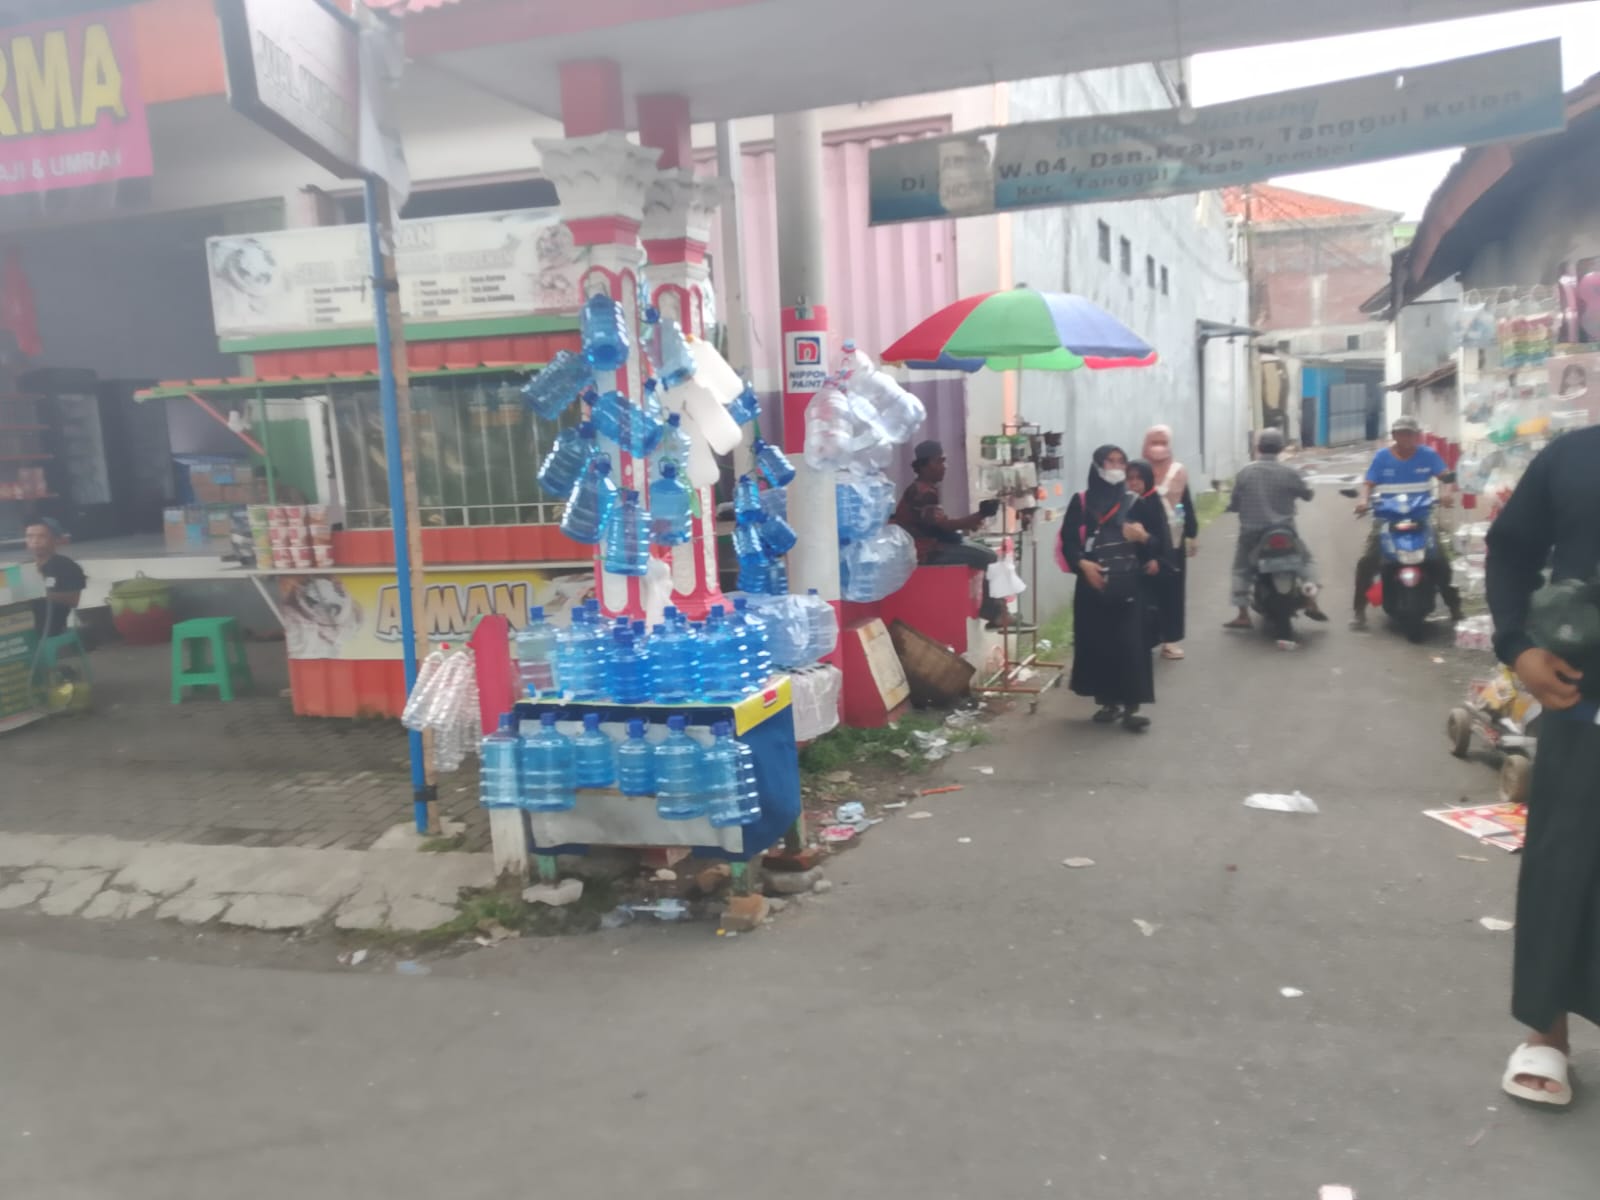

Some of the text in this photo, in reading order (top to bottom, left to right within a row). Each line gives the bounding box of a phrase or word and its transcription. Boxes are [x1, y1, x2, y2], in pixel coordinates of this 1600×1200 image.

[901, 176, 927, 192] Di
[1279, 106, 1407, 142] Tanggul
[376, 582, 529, 636] AMAN
